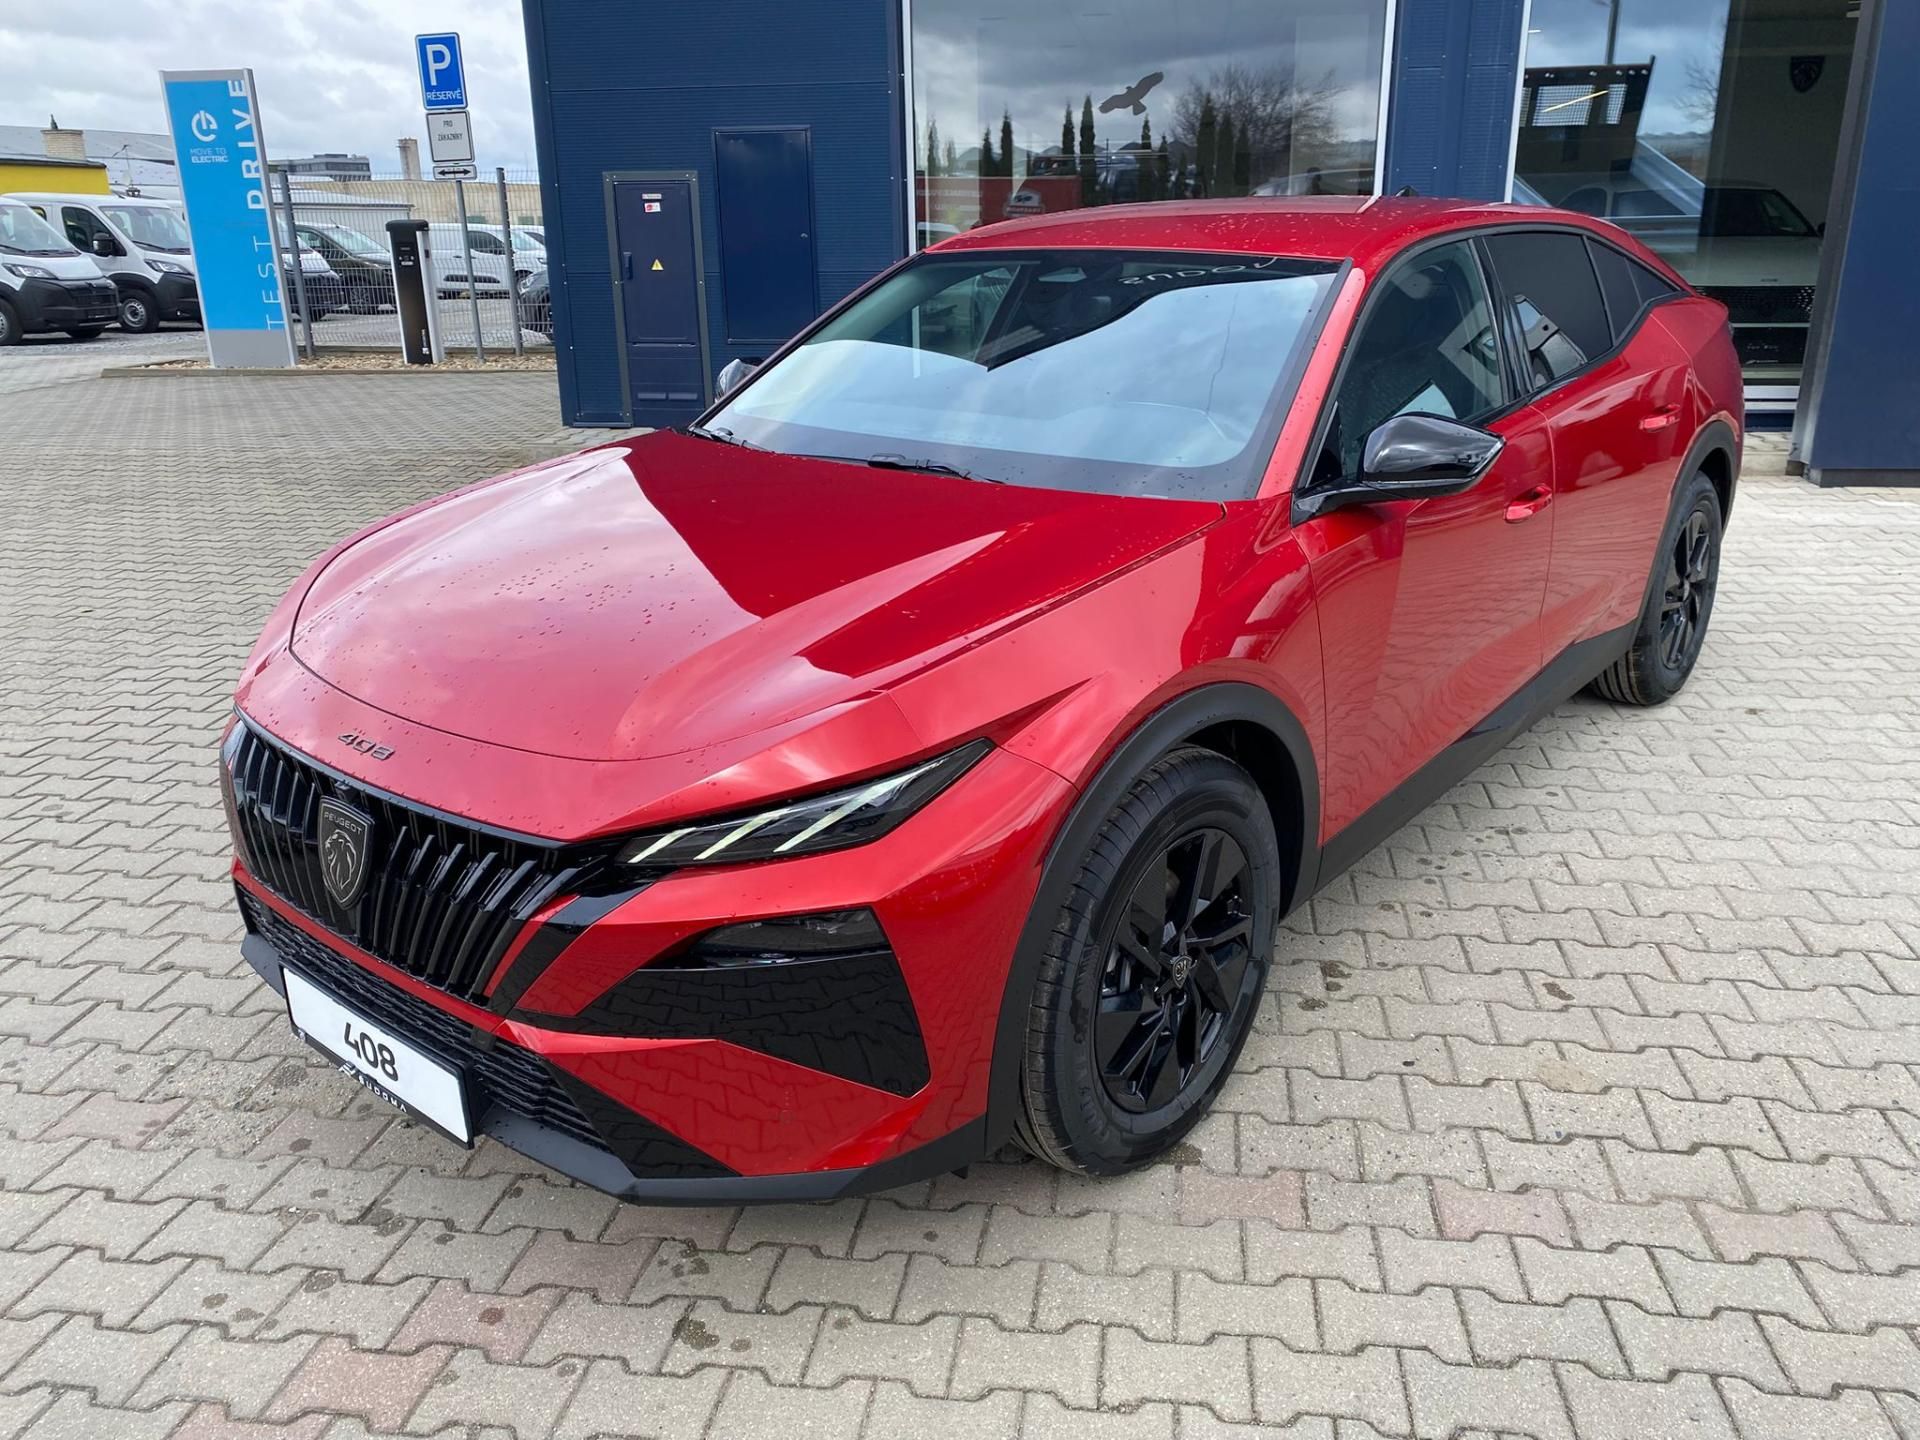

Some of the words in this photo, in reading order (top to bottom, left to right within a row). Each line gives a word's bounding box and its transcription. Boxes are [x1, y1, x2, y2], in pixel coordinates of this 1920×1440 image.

[425, 43, 452, 87] P
[426, 88, 462, 100] RÉSERVÉ
[190, 147, 213, 155] MOVE
[215, 147, 228, 155] TO
[227, 79, 266, 210] DRIVE
[191, 155, 229, 164] ELECTRIC
[253, 235, 286, 331] TEST
[338, 733, 396, 761] 408
[323, 811, 362, 835] PEUGEOT
[343, 1021, 399, 1082] 408
